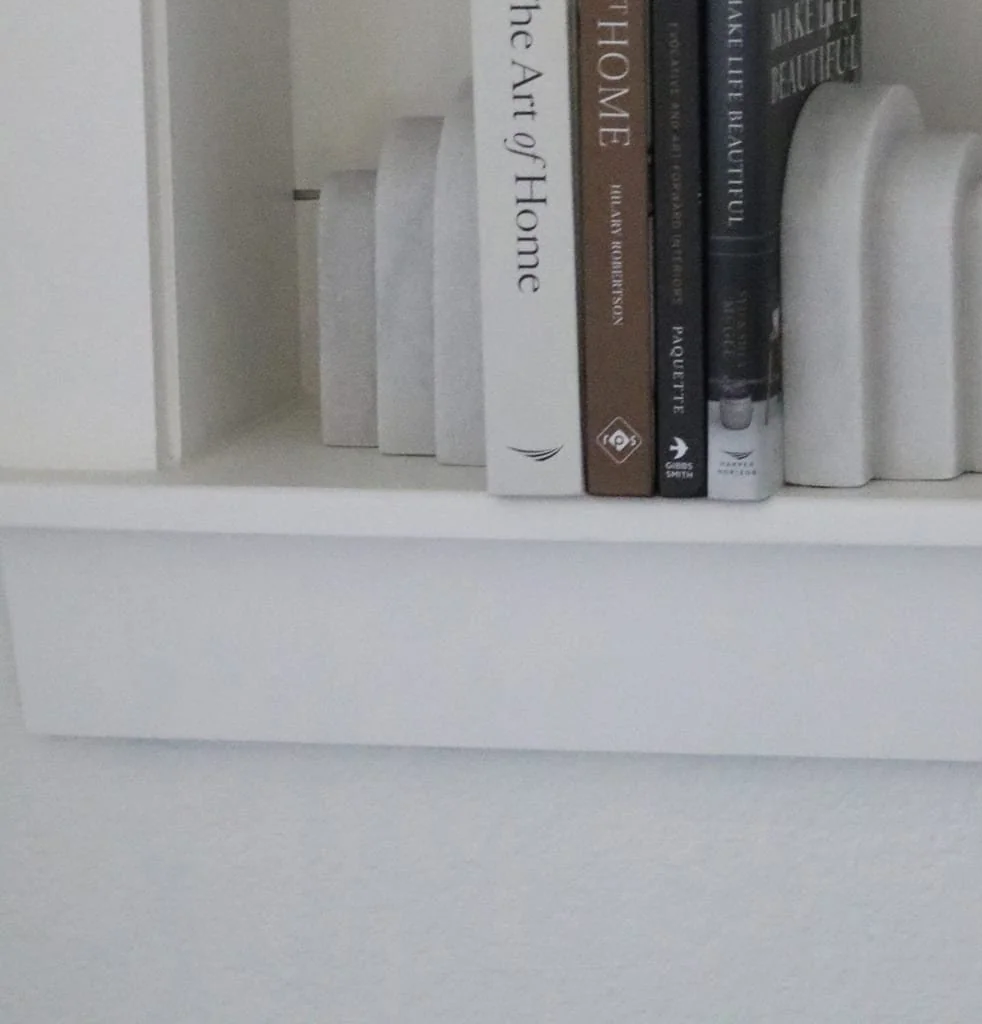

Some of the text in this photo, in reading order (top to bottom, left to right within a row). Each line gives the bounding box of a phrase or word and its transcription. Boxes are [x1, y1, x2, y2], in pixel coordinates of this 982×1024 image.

[511, 61, 544, 119] Art
[597, 19, 631, 147] HOME
[727, 56, 744, 103] LIFE
[770, 35, 859, 104] BEAUTIFUL
[504, 132, 547, 168] of
[727, 109, 745, 227] BEAUTIFUL
[514, 168, 549, 294] Home
[608, 183, 625, 327] HILARY ROBERTSON
[669, 327, 685, 415] PAQUETTE
[665, 470, 695, 479] SMITH
